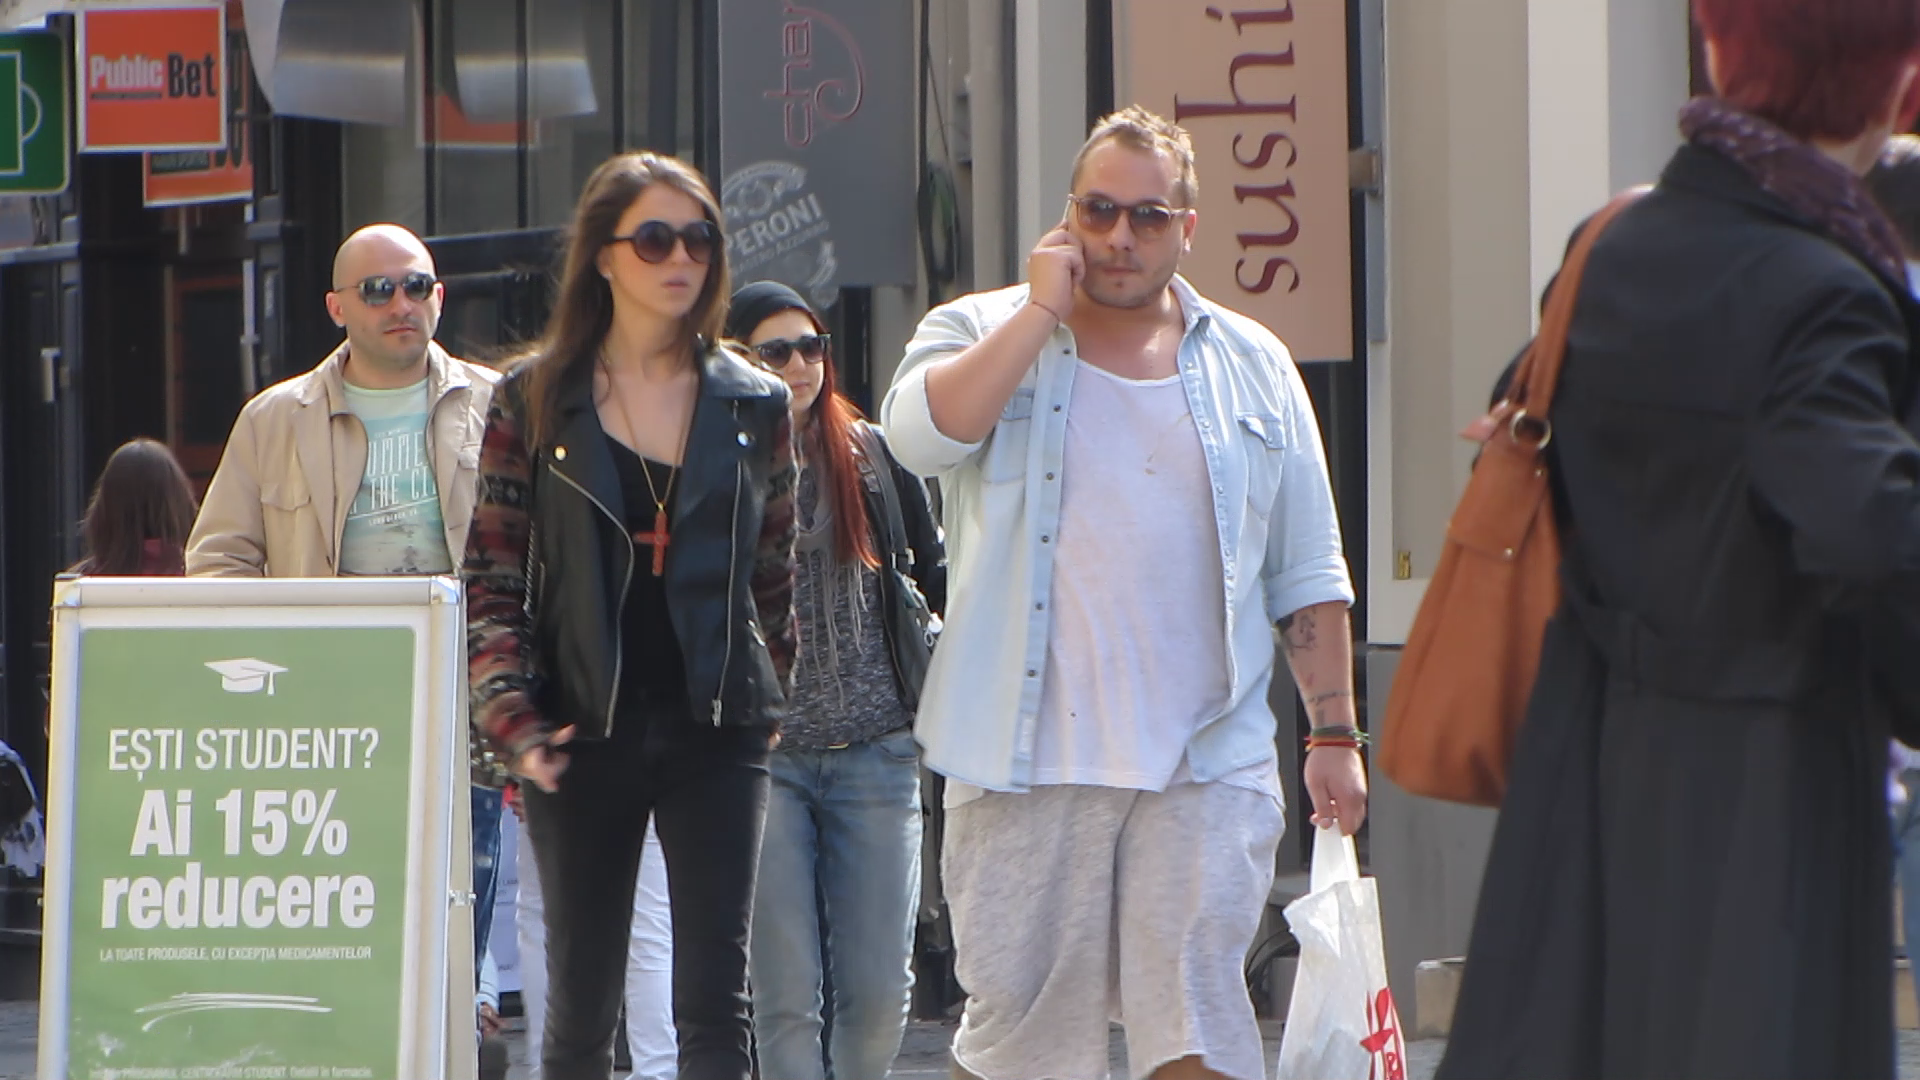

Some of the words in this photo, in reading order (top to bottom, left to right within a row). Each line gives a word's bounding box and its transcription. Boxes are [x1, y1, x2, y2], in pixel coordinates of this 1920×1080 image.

[90, 54, 163, 89] Public
[168, 52, 217, 98] Bet
[1174, 0, 1299, 294] sushi
[367, 431, 426, 477] UMME
[371, 473, 400, 510] THE
[195, 727, 379, 770] STUDENT?
[129, 789, 192, 856] Ai
[215, 789, 348, 856] 15%
[101, 861, 375, 929] reducere
[100, 948, 115, 961] LA
